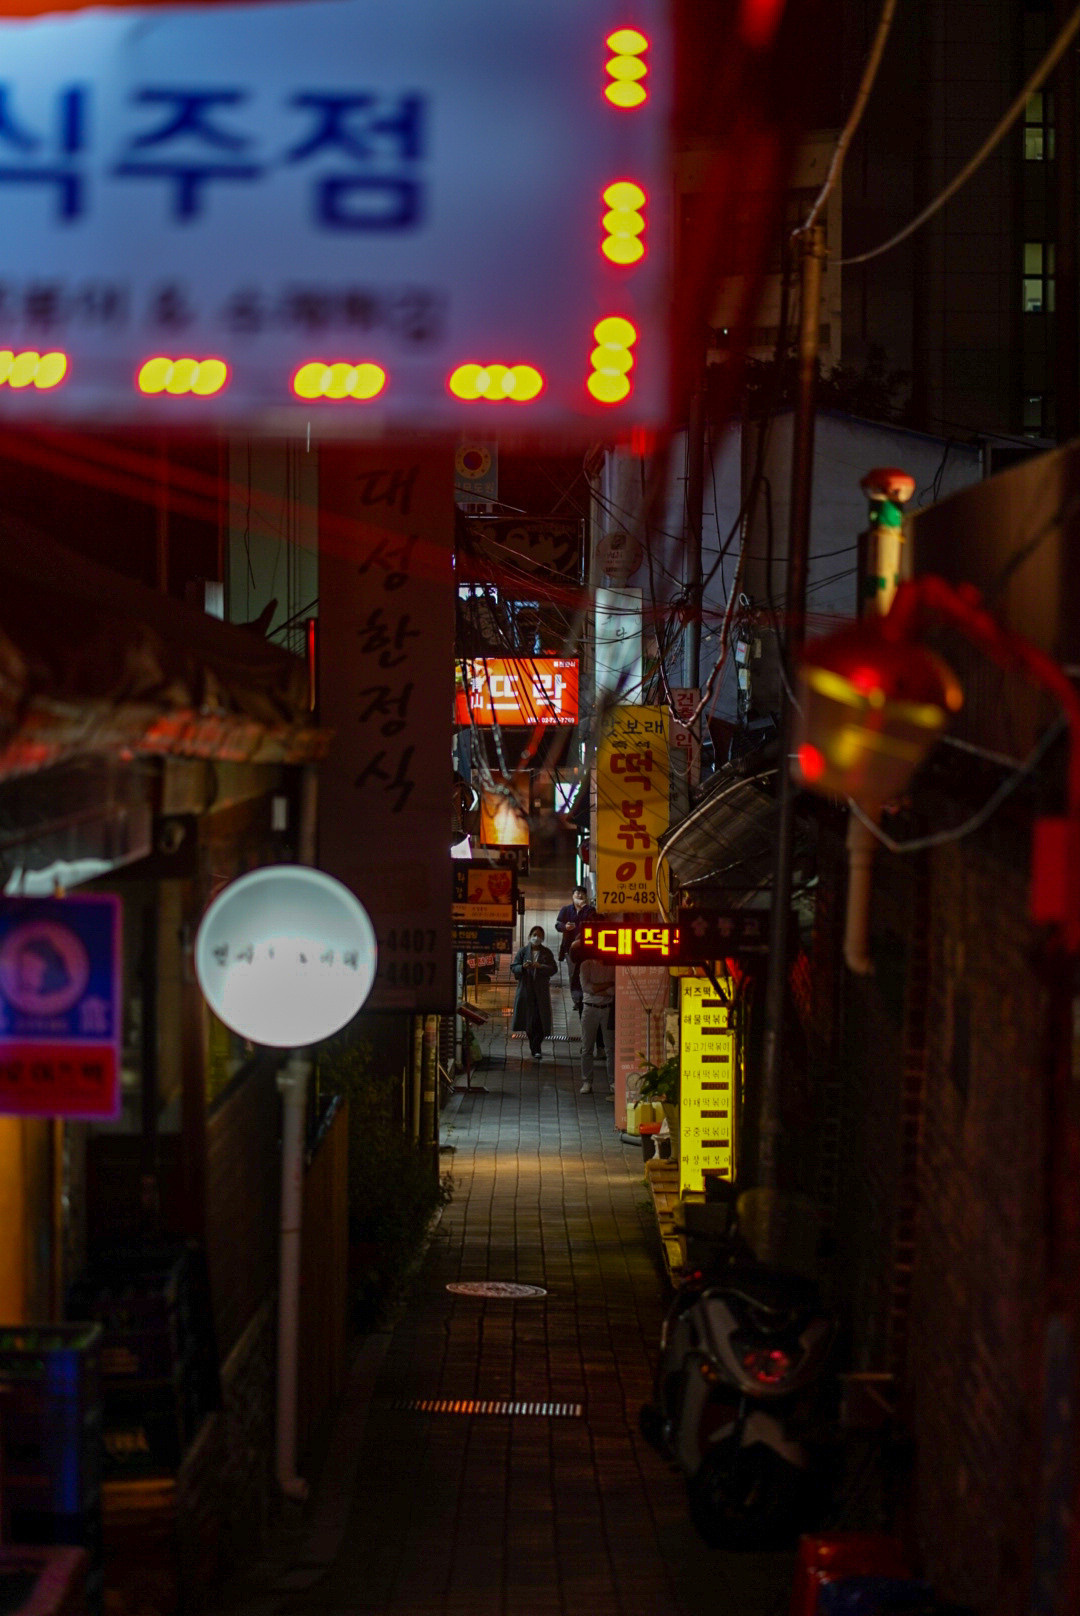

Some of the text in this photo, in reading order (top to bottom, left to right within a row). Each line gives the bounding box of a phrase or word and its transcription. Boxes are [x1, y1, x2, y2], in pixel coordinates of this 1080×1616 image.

[0, 88, 428, 232] 식주점
[486, 674, 567, 714] 뜨락
[609, 749, 654, 882] 떡볶이
